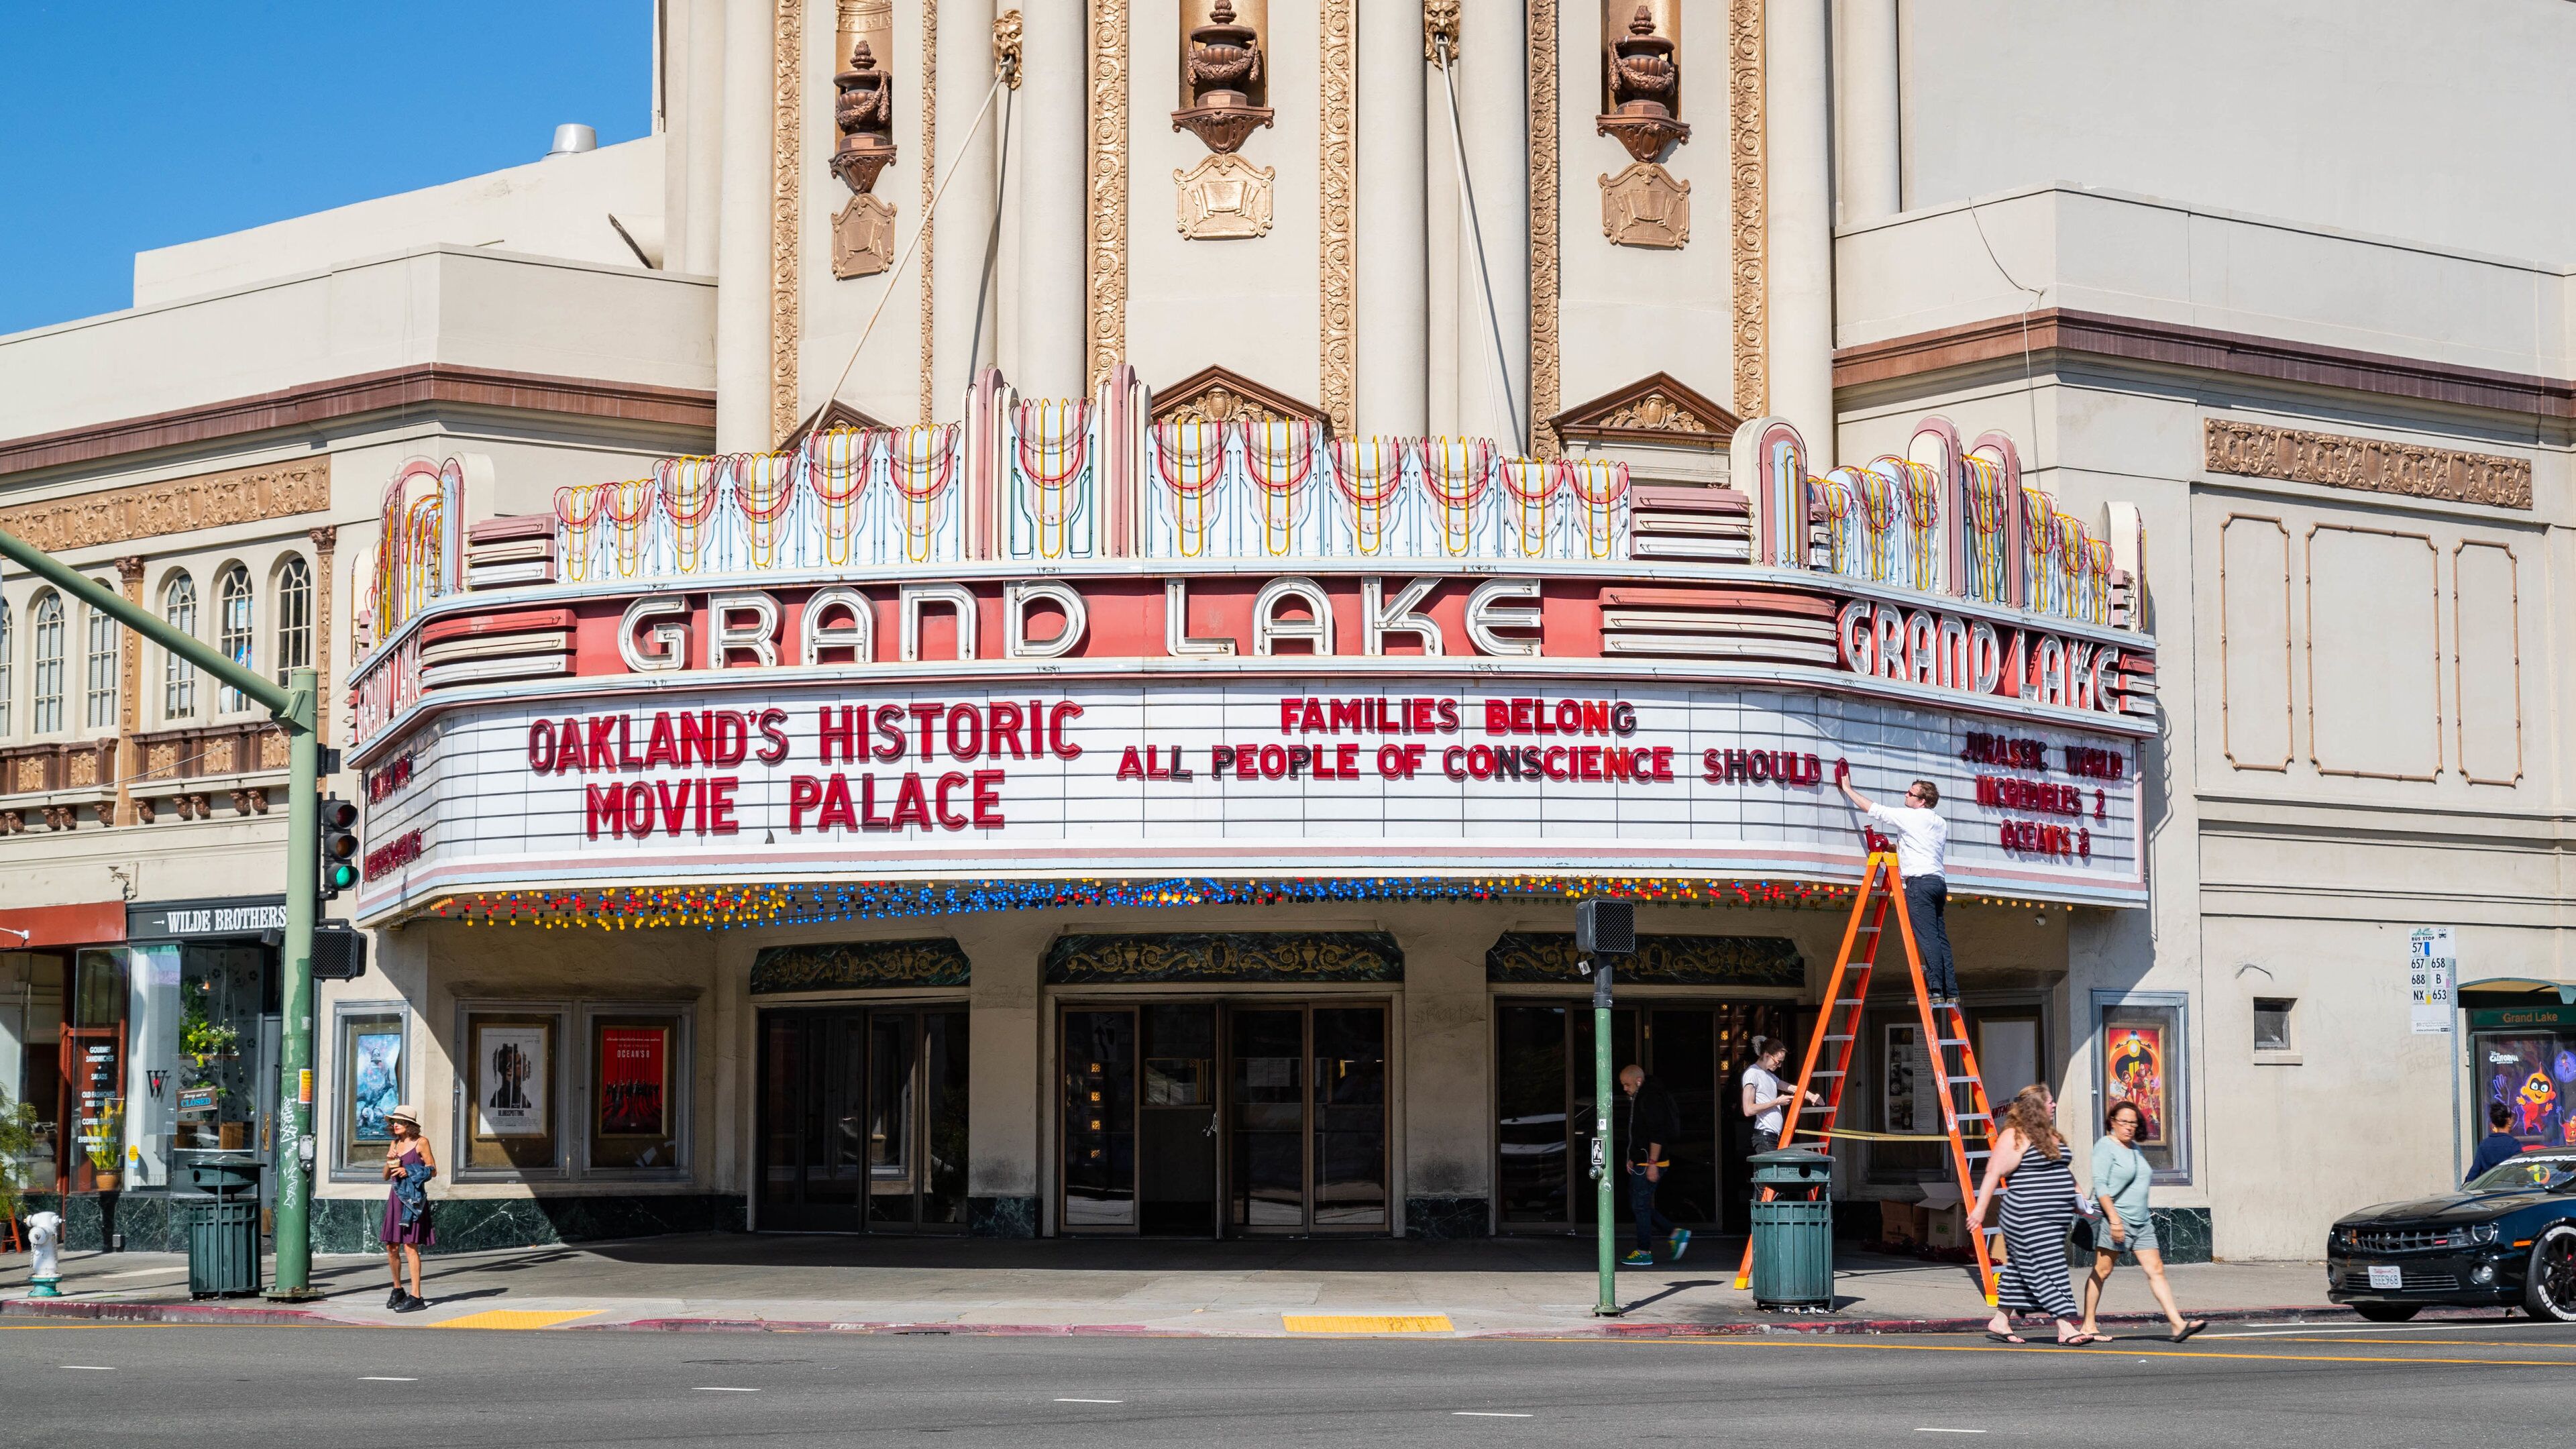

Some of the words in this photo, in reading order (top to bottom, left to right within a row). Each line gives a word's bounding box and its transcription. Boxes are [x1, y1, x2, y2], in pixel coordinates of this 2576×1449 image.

[618, 580, 1087, 672] GRAND
[1165, 576, 1542, 657] LAKE
[1842, 598, 2000, 694] GRAND
[2017, 629, 2119, 714] LAKE
[358, 651, 391, 745] GRAND
[394, 627, 423, 716] LAKE
[1281, 698, 1460, 735] FAMILIES
[1485, 698, 1637, 736] BELONG
[529, 707, 789, 774] OAKLAND'S
[819, 700, 1083, 765] HISTORIC
[1117, 745, 1193, 780] ALL
[1212, 743, 1359, 780] PEOPLE
[1377, 743, 1426, 780] OF
[1443, 744, 1674, 782] CONSCIENCE
[1703, 748, 1821, 786] SHOULD
[1961, 731, 2049, 772] JURASSIC
[2065, 745, 2123, 781] WORLD
[586, 775, 739, 840] MOVIE
[790, 769, 1006, 833] PALACE
[1976, 775, 2082, 816] INCREDIBLES
[2094, 788, 2106, 819] 2
[2079, 827, 2090, 857] 8
[167, 910, 211, 933] WILDE
[215, 905, 286, 931] BROTHERS
[2412, 943, 2422, 953] 57
[2412, 959, 2424, 969] 657
[2431, 958, 2445, 968] 658
[2412, 974, 2425, 984] 688
[2436, 974, 2441, 984] B
[2414, 990, 2424, 1000] NX
[2432, 989, 2447, 1000] 653
[2503, 1012, 2532, 1023] Grand
[2536, 1012, 2558, 1022] Lake
[616, 1049, 645, 1058] OCEAN'S
[646, 1050, 650, 1058] 8
[180, 1097, 211, 1108] CLOSED
